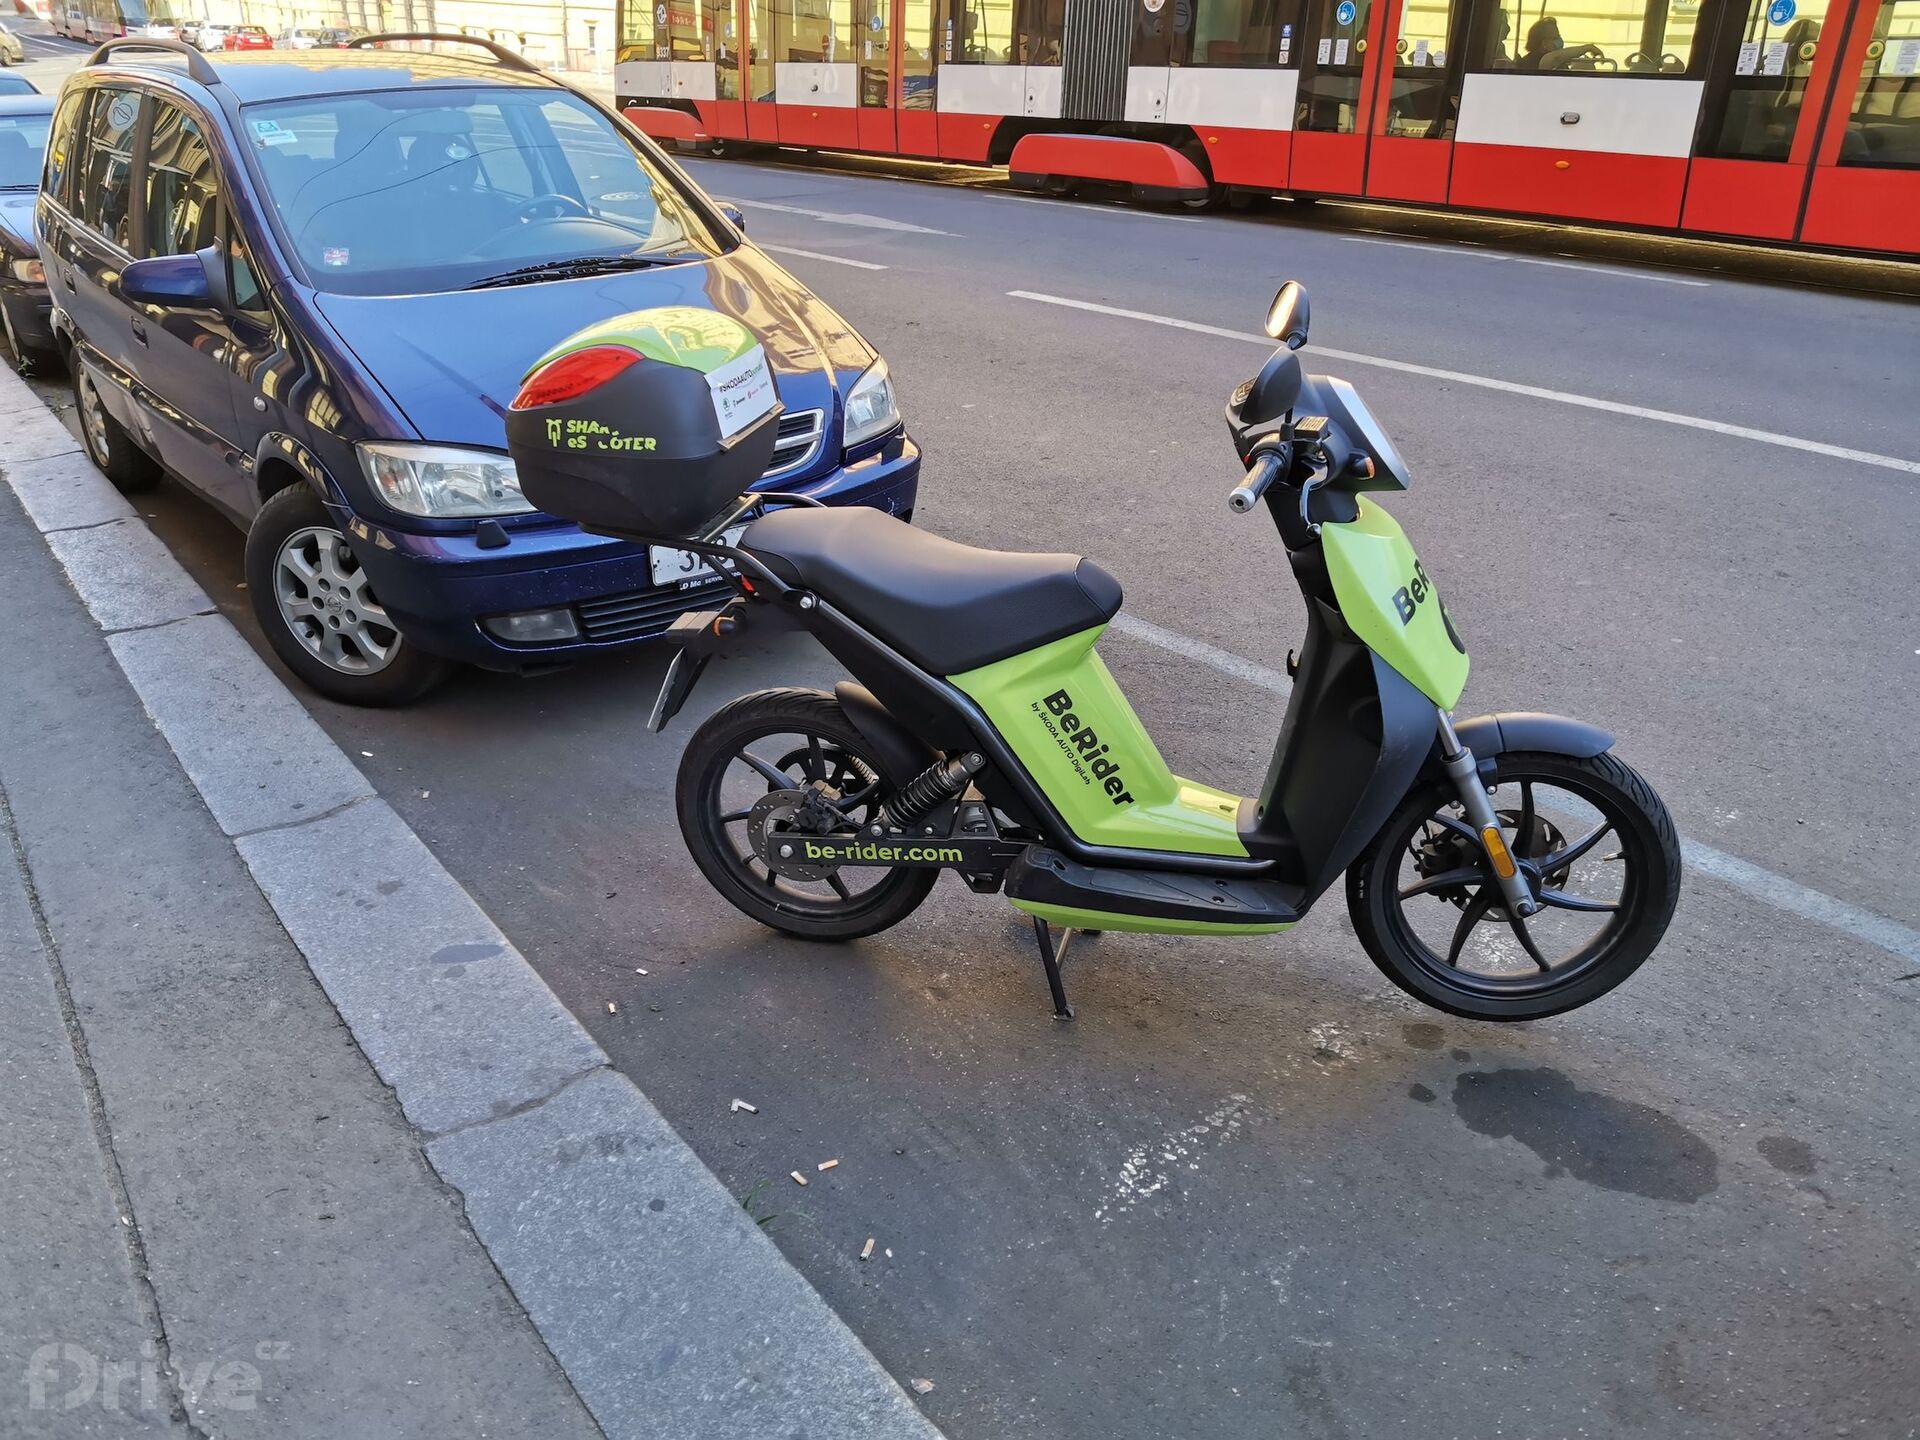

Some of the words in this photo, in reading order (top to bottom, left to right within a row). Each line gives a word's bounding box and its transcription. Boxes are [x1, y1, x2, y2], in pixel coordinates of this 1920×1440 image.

[1031, 702, 1041, 713] by
[1056, 738, 1074, 759] AUTO
[1071, 758, 1091, 785] DigiLab
[1043, 688, 1135, 806] BeRider
[805, 841, 963, 862] be-rider.com
